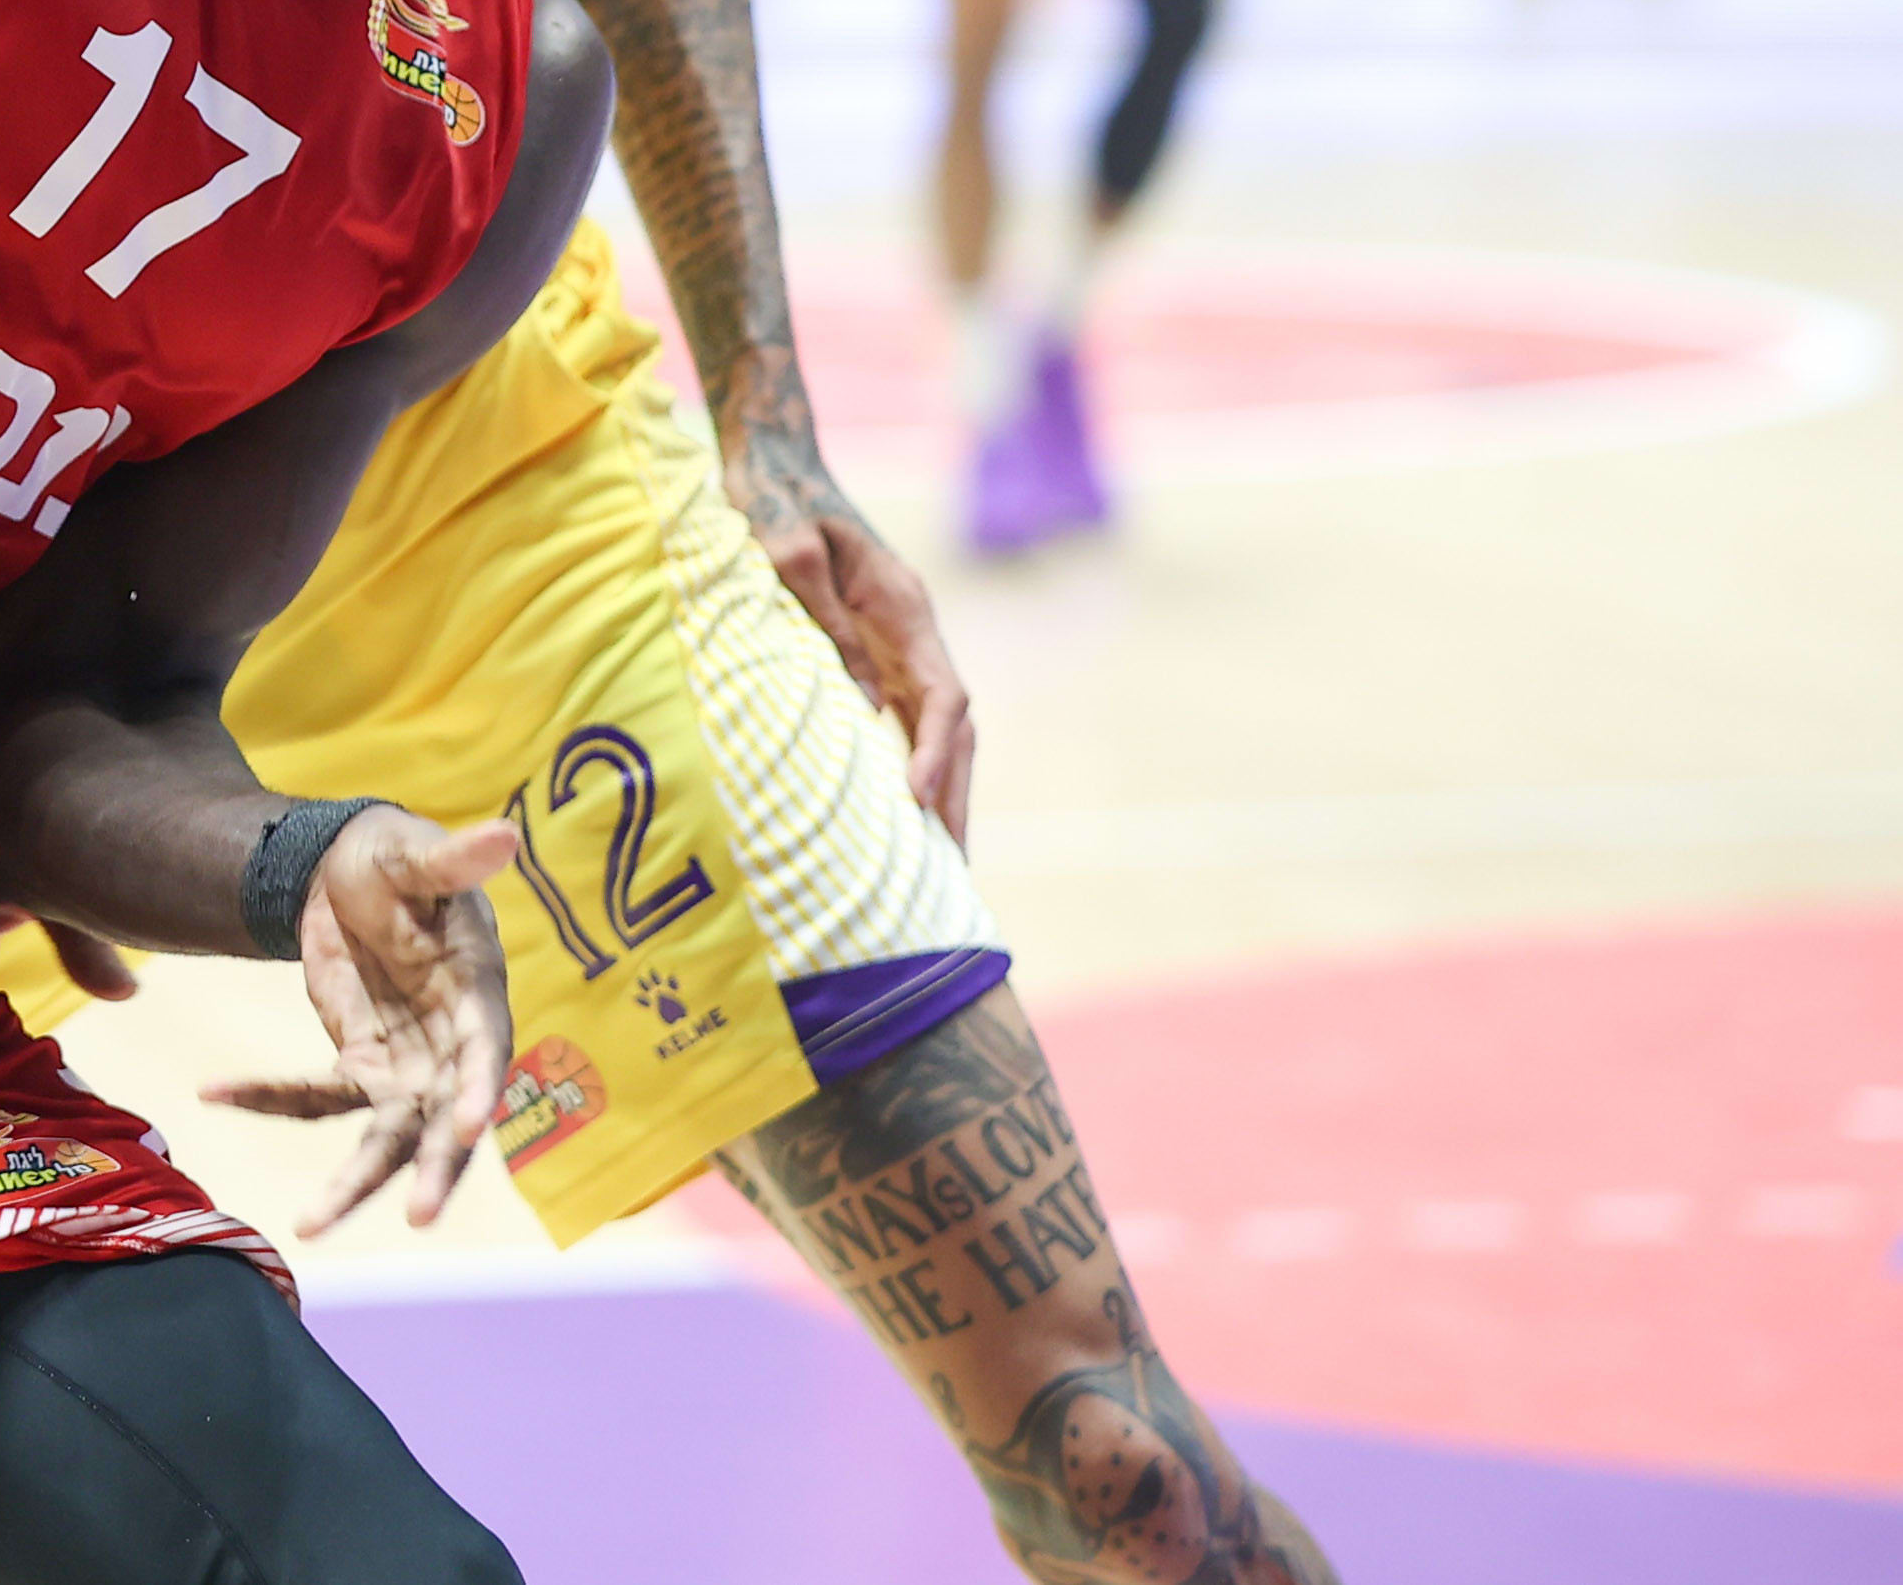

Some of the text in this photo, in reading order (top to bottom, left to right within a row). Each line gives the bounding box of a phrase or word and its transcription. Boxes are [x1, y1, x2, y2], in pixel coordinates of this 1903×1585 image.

[10, 20, 302, 299] 17
[503, 723, 715, 981] 12
[6, 1146, 45, 1170] ליגת
